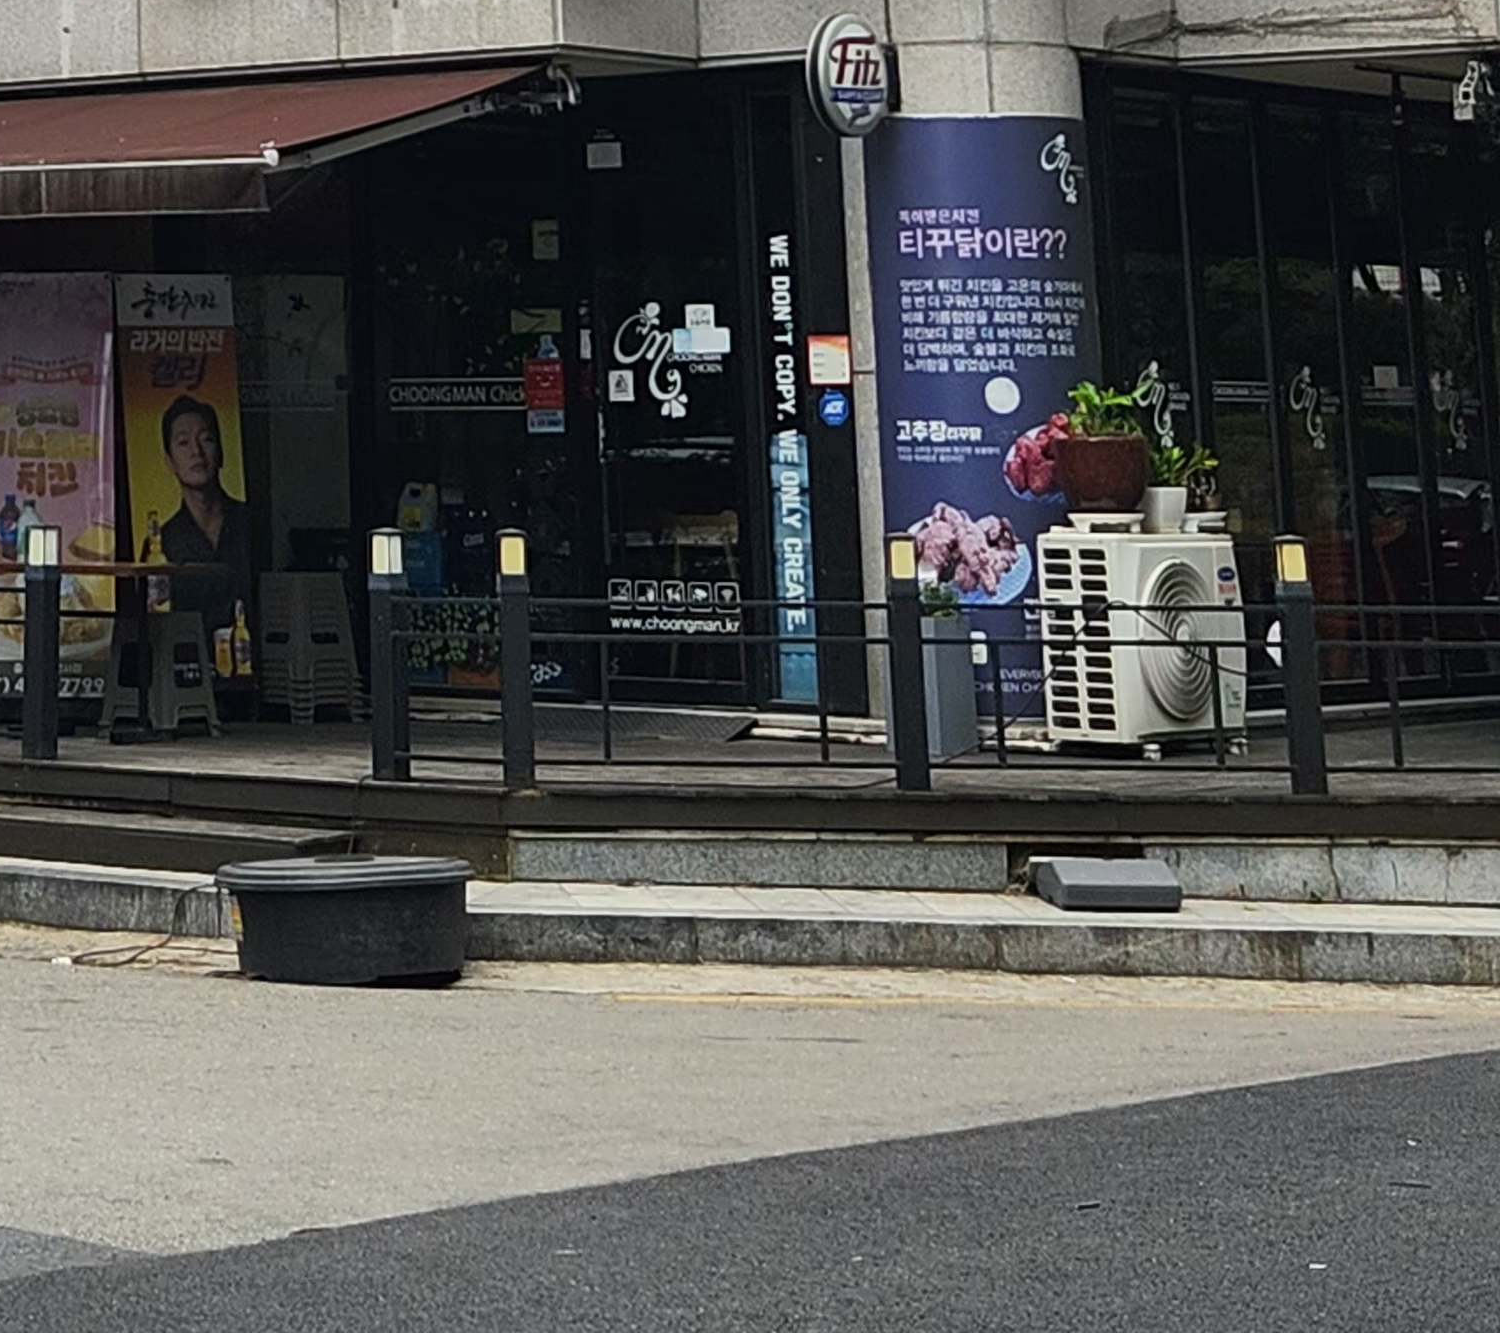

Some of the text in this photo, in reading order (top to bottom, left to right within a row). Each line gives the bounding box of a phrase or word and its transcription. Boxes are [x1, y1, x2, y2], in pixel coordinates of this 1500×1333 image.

[769, 234, 788, 268] WE
[388, 387, 487, 405] CHOONGMAN
[775, 354, 796, 423] COPY.
[777, 429, 798, 464] WE
[780, 469, 801, 530] ONLY
[609, 615, 741, 634] www.choongman.kr
